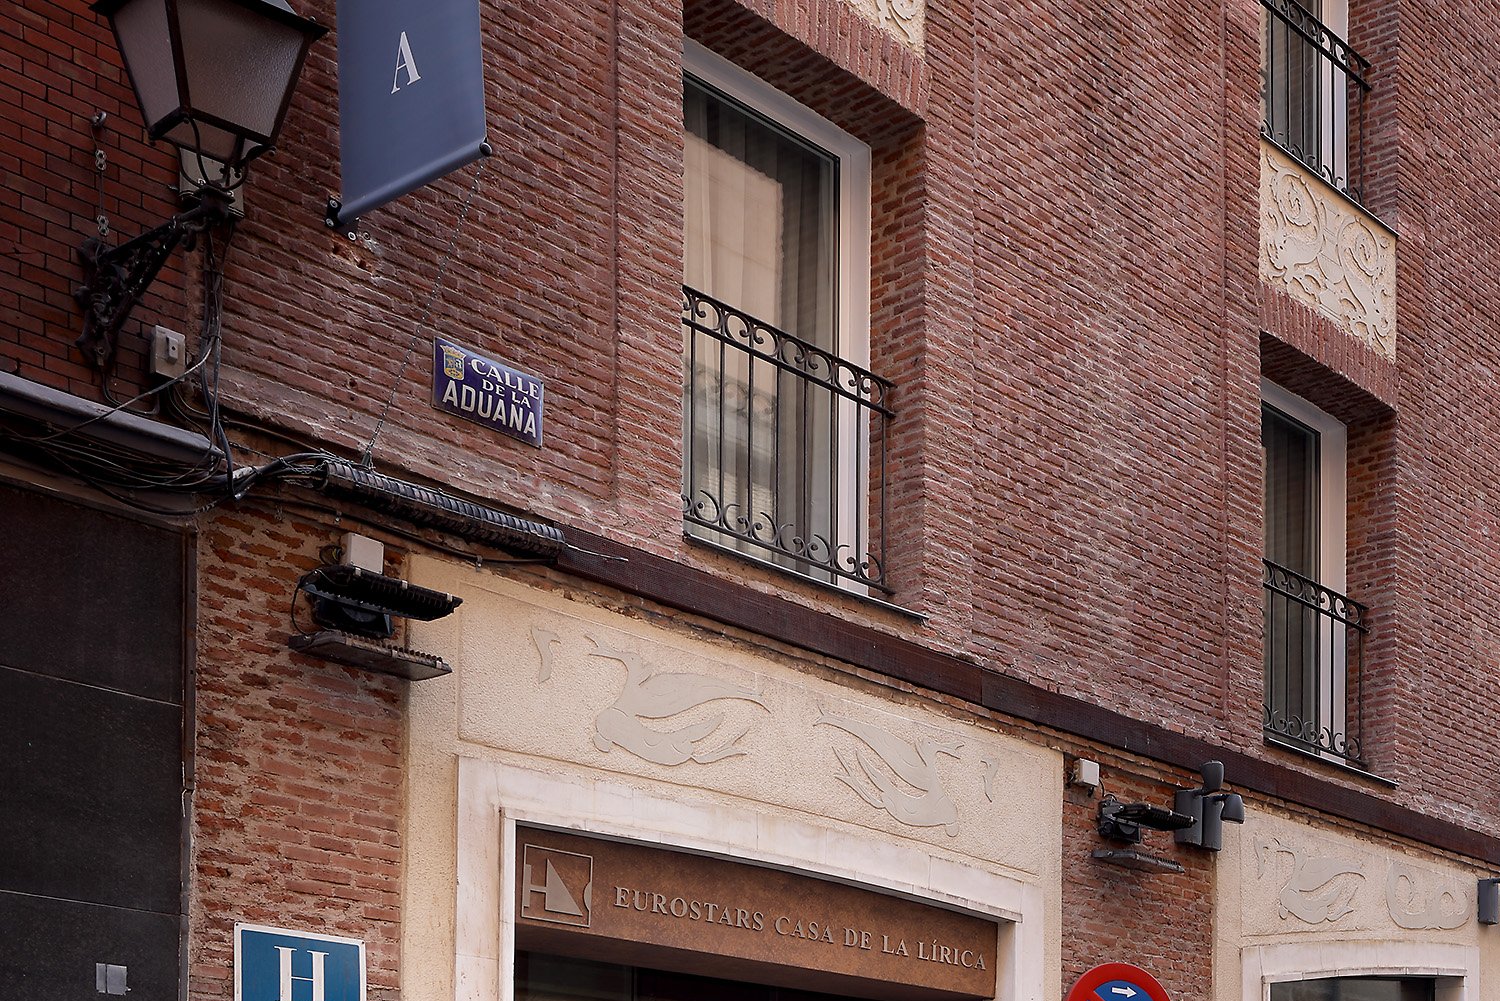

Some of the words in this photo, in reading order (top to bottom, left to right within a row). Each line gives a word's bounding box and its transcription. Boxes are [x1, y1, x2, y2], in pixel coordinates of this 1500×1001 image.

[391, 31, 422, 94] A
[442, 379, 537, 438] ADUANA
[470, 358, 540, 400] CALLE
[481, 378, 506, 397] DE
[511, 391, 531, 409] LA
[613, 886, 765, 931] EUROSTARS
[774, 915, 835, 944] CASA
[843, 927, 873, 950] DE
[881, 934, 910, 957] LA
[916, 939, 987, 970] LÍRICA
